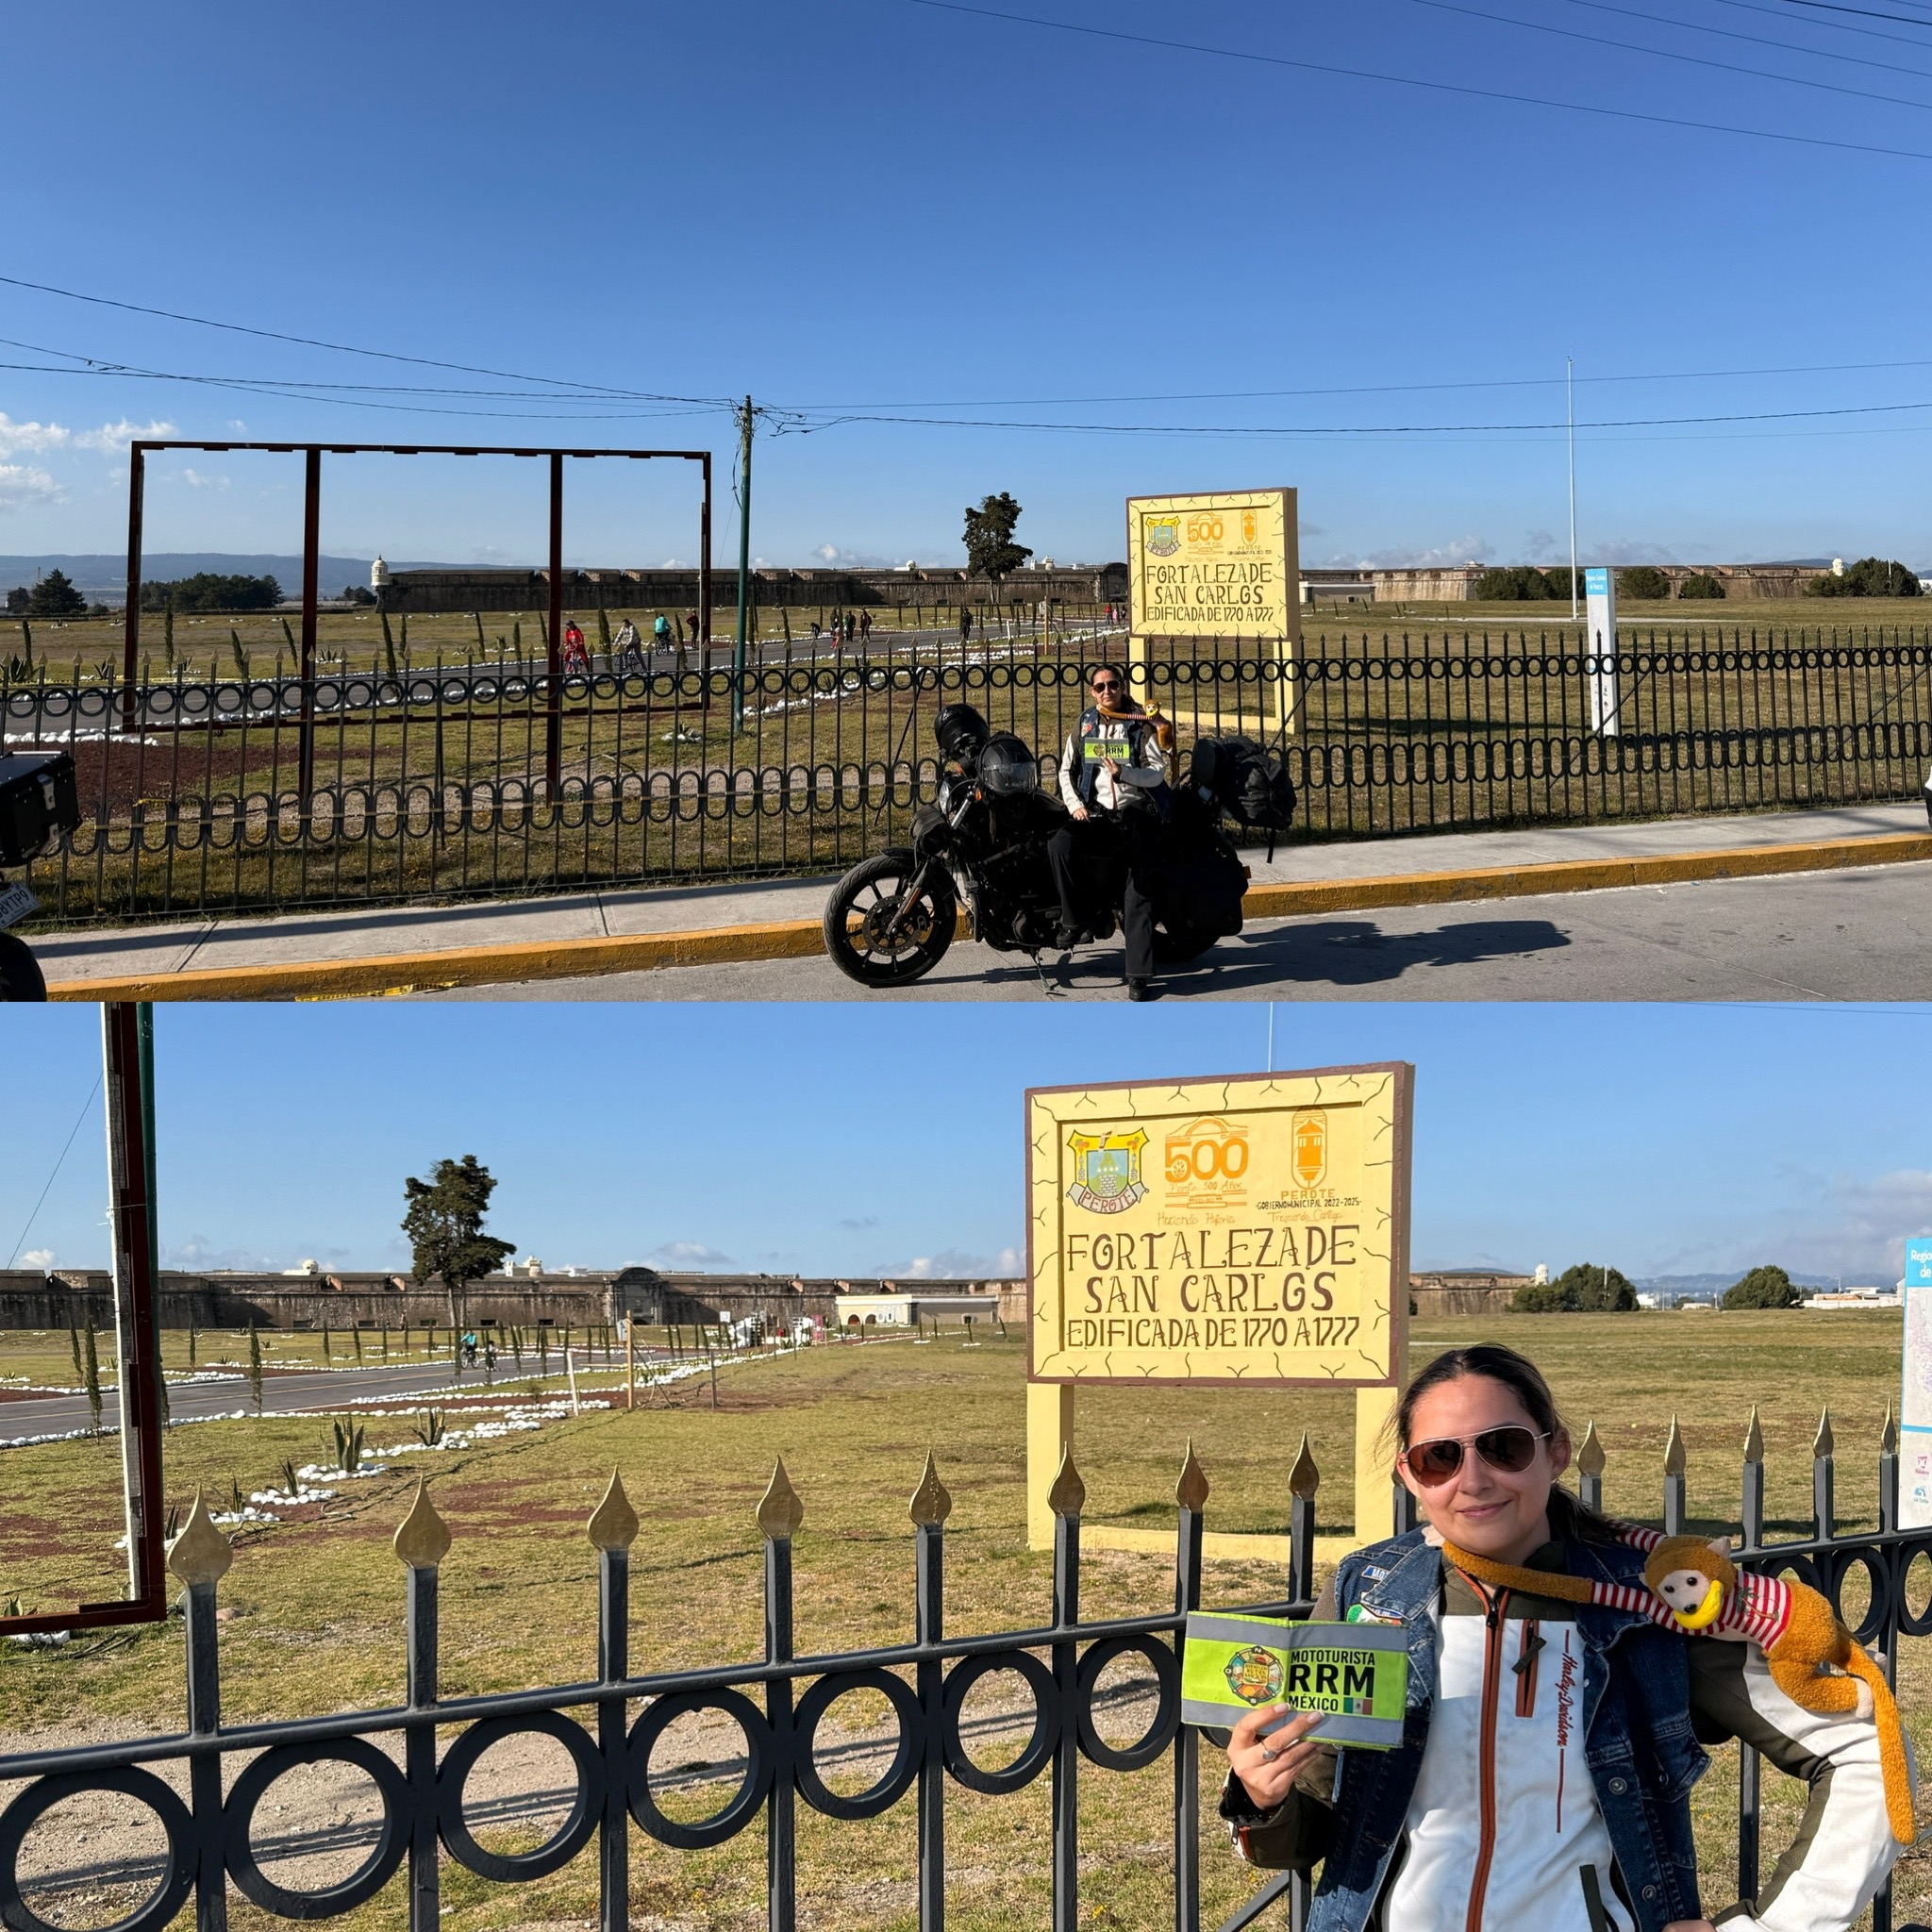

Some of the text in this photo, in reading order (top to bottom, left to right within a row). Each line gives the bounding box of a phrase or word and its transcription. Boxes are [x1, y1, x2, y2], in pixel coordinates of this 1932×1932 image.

[1188, 521, 1224, 542] 500
[1154, 585, 1264, 605] SAN CARLOS
[1224, 607, 1243, 622] 1770
[0, 890, 28, 918] 8YTP9
[1164, 1138, 1248, 1183] 500
[1203, 1181, 1218, 1191] 500
[1280, 1189, 1335, 1200] PEROTE
[1080, 1189, 1135, 1212] PEROTE
[1920, 1264, 1932, 1278] de
[1084, 1272, 1336, 1314] SAN CARLOS
[1242, 1318, 1288, 1347] 1770
[1291, 1650, 1375, 1666] MOTOTURISTA
[1289, 1663, 1374, 1698] RRM
[1289, 1693, 1339, 1711] MÉXICO
[1555, 1653, 1578, 1747] Harley-Davidson
